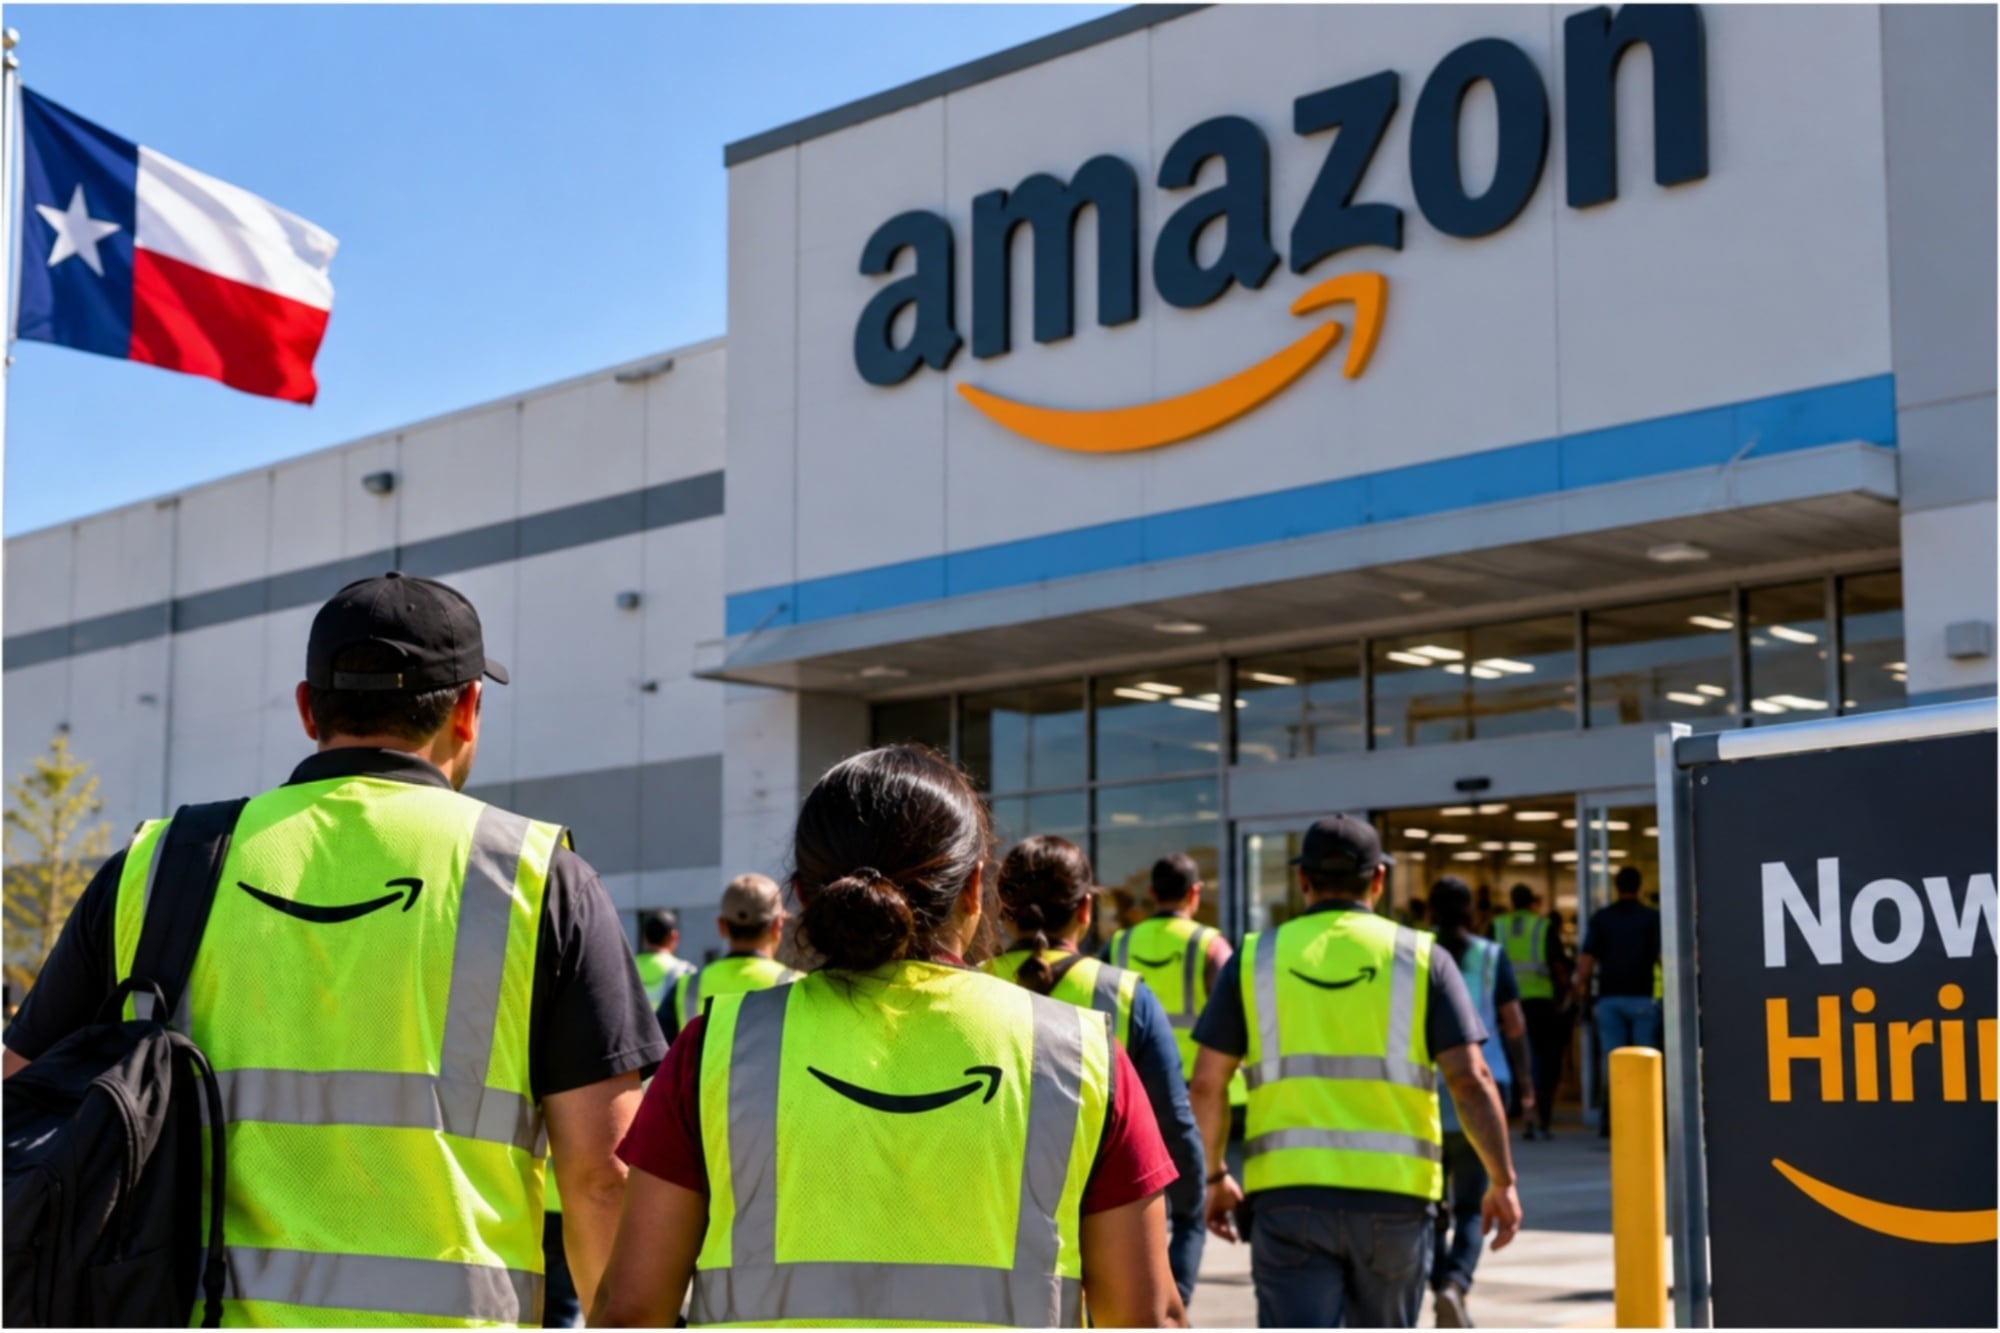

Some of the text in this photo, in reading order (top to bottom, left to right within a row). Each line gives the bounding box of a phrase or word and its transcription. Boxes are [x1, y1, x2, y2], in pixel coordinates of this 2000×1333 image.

[853, 4, 1709, 387] amazon
[1761, 857, 1998, 967] Now
[1765, 983, 1998, 1102] Hiri
